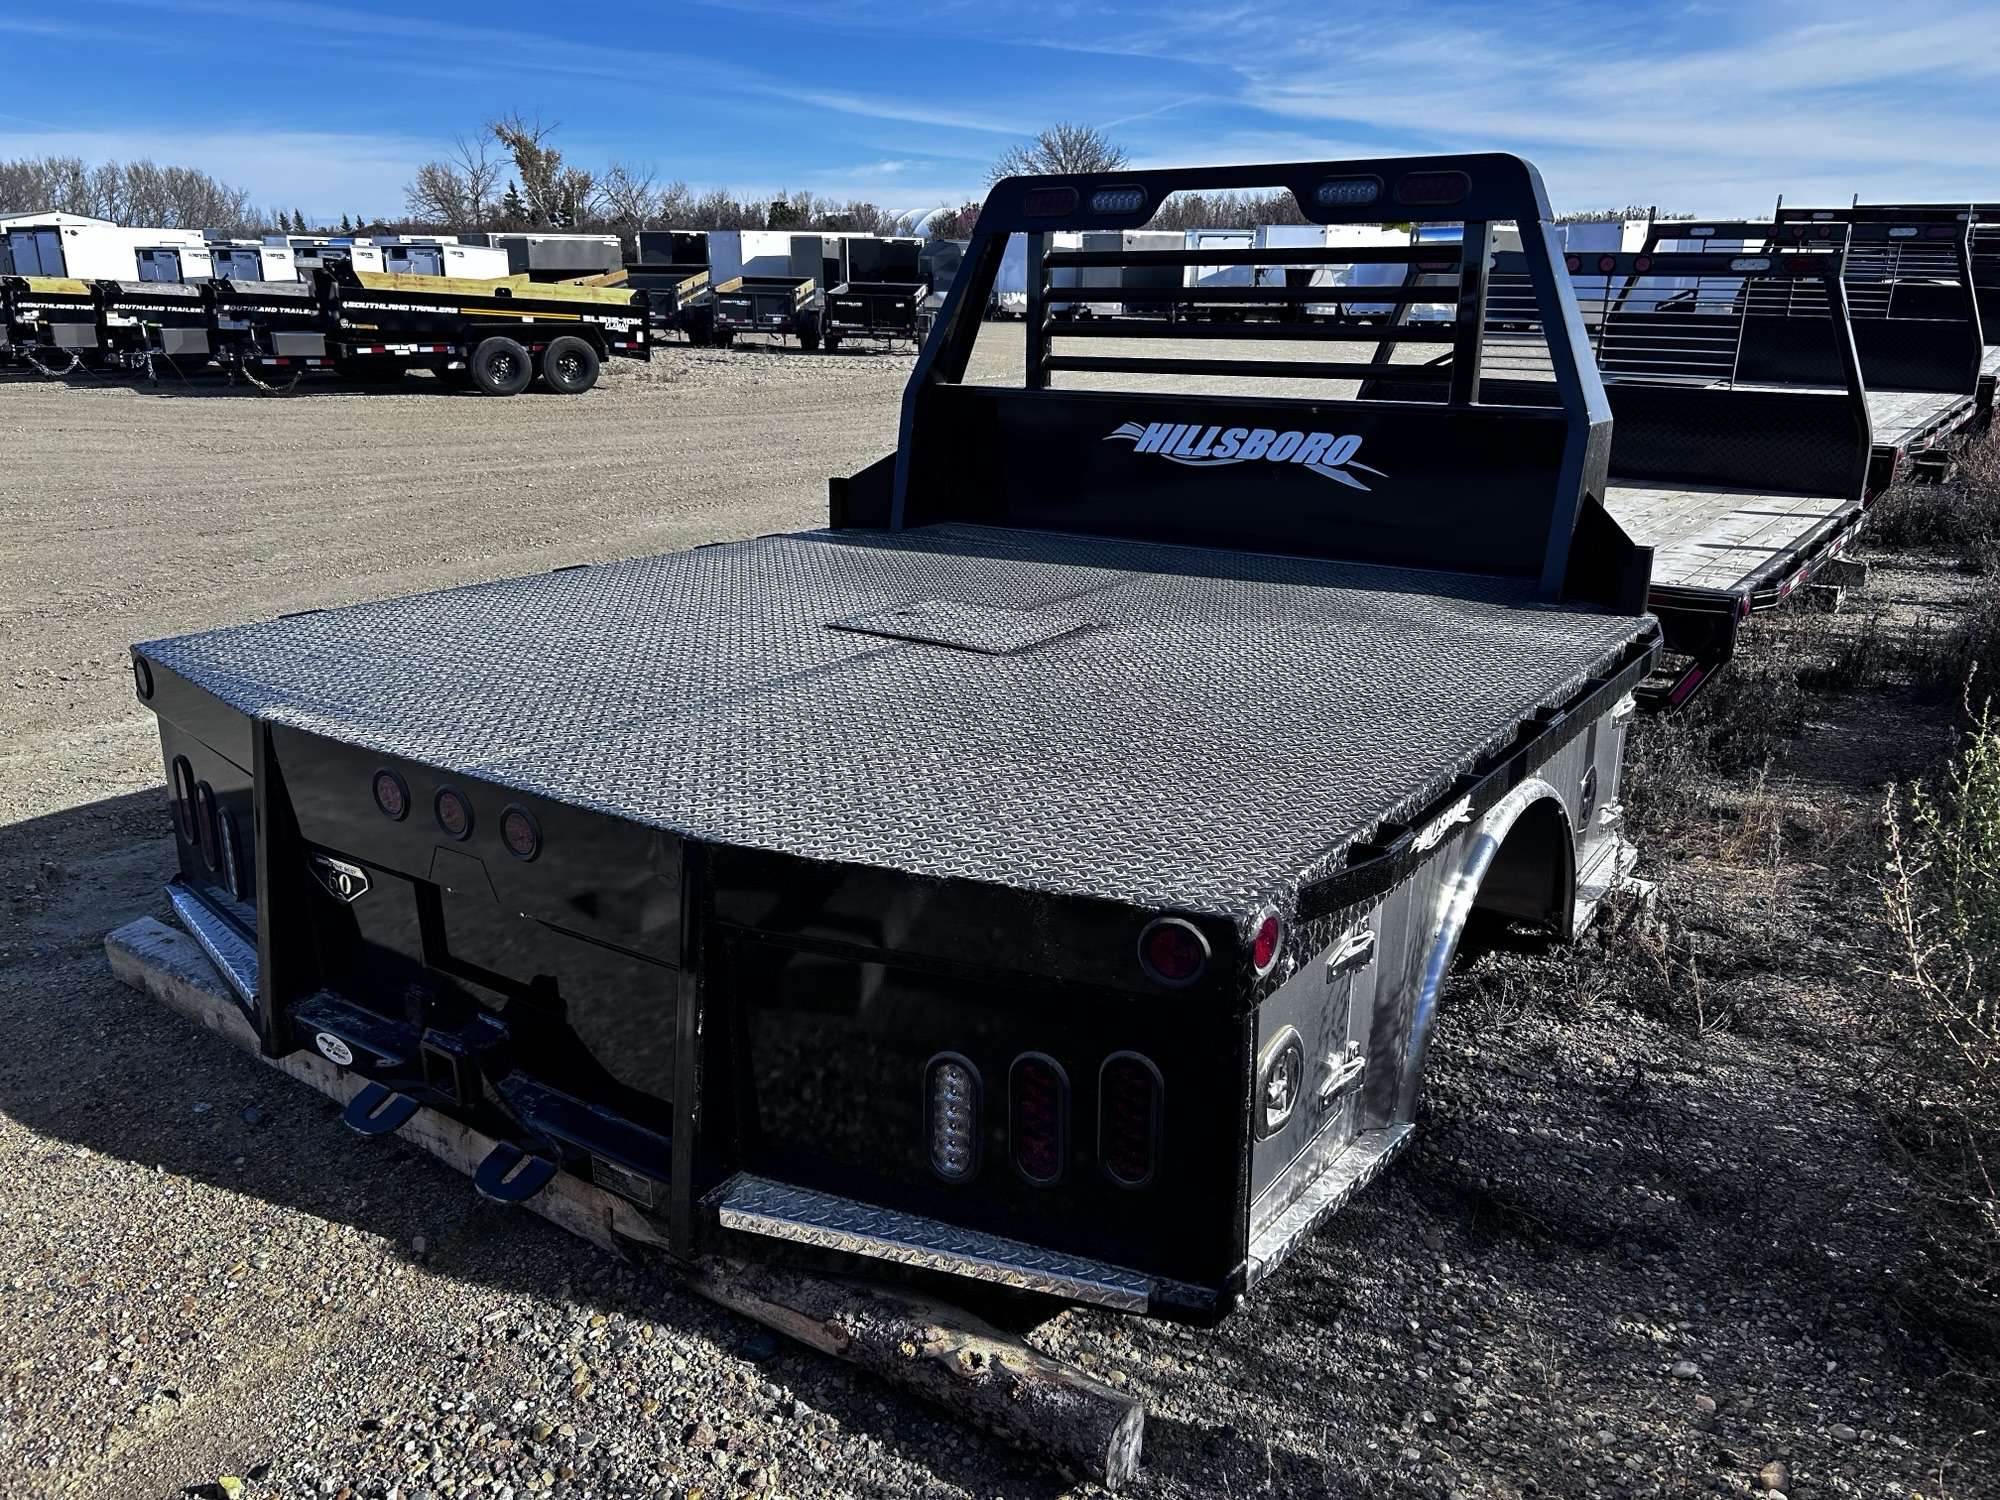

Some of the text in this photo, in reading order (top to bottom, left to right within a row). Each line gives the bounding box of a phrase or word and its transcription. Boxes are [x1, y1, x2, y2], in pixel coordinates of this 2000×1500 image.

[112, 303, 165, 311] SOUTHLAND
[223, 304, 277, 313] SOUTHLAND
[347, 301, 458, 314] SOUTHLAND TRAILERS
[1134, 422, 1363, 466] HILLSBORO
